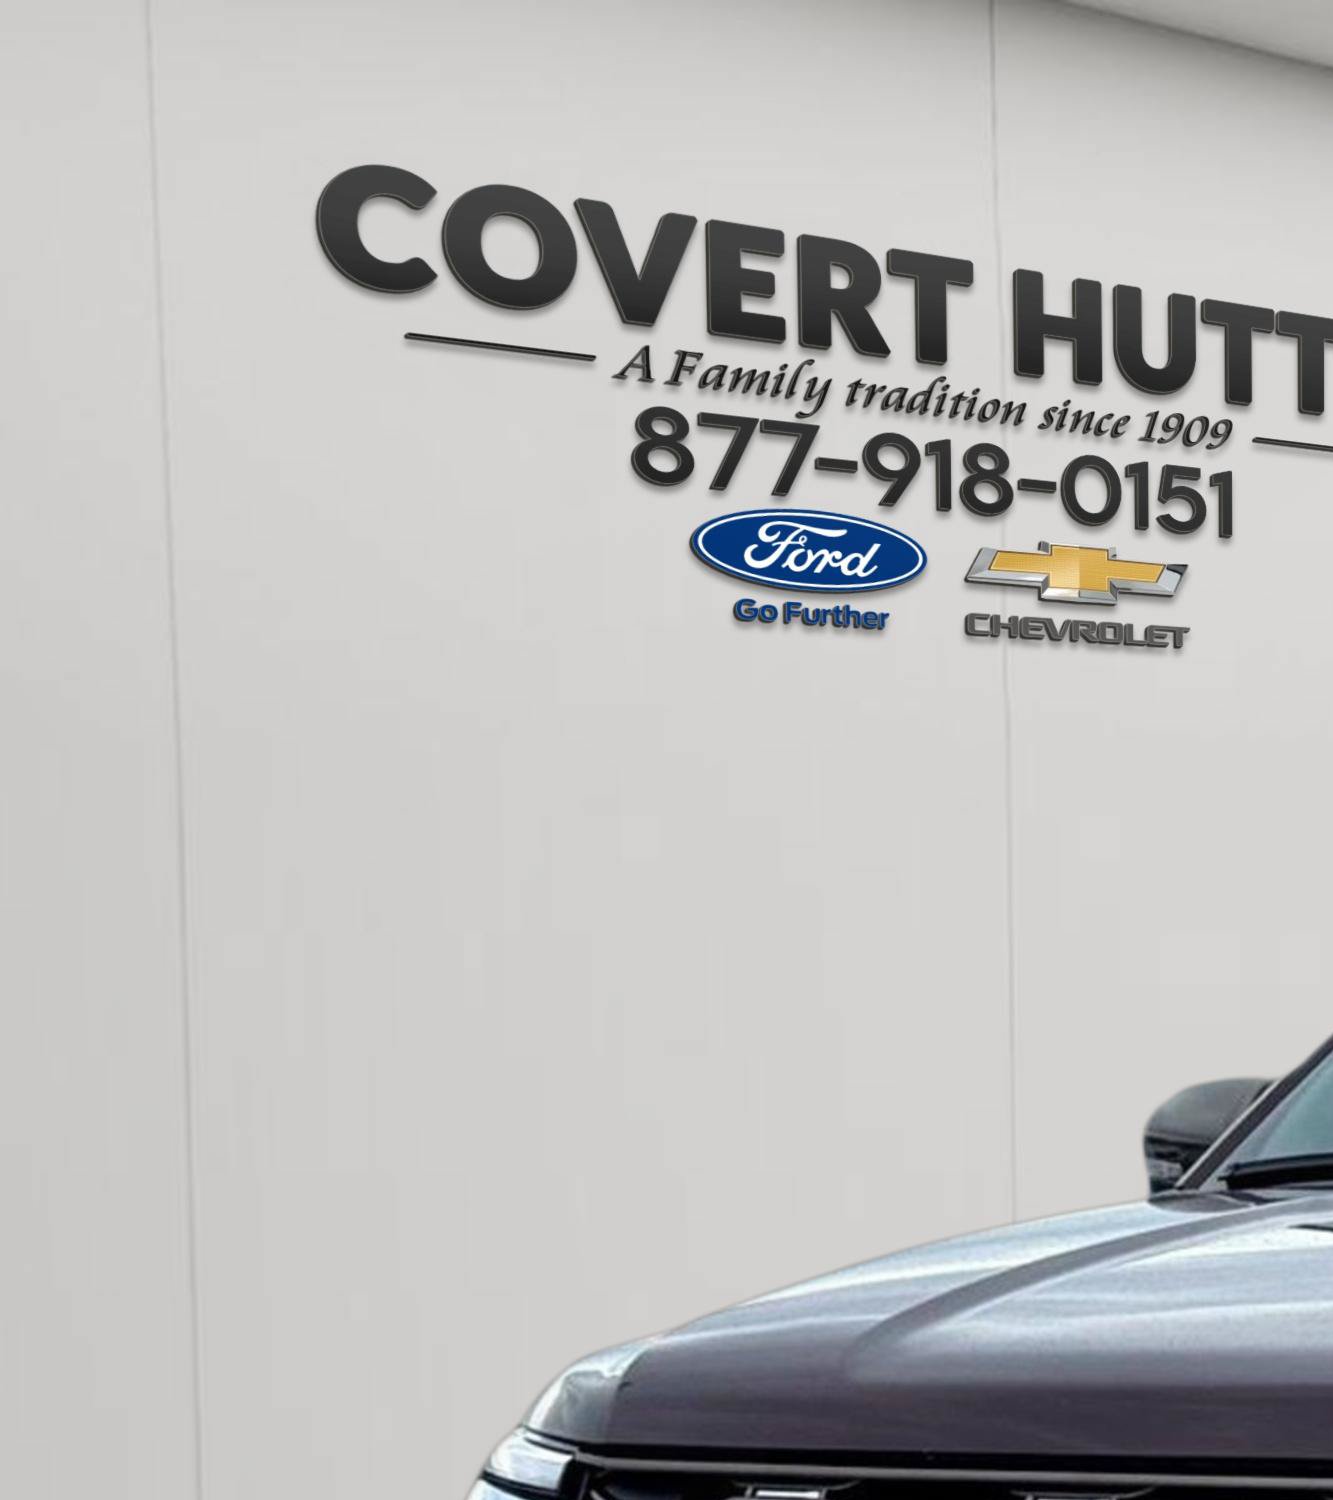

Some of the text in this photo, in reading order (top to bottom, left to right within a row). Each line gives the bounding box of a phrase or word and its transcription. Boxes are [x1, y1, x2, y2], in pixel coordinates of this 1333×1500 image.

[315, 164, 974, 367] COVERT
[612, 344, 1234, 451] A Family tradition since 1909
[630, 406, 1233, 540] 877-918-0151
[743, 519, 881, 579] Ford
[732, 598, 890, 631] Go Further
[964, 612, 1191, 650] CHEVROLET
